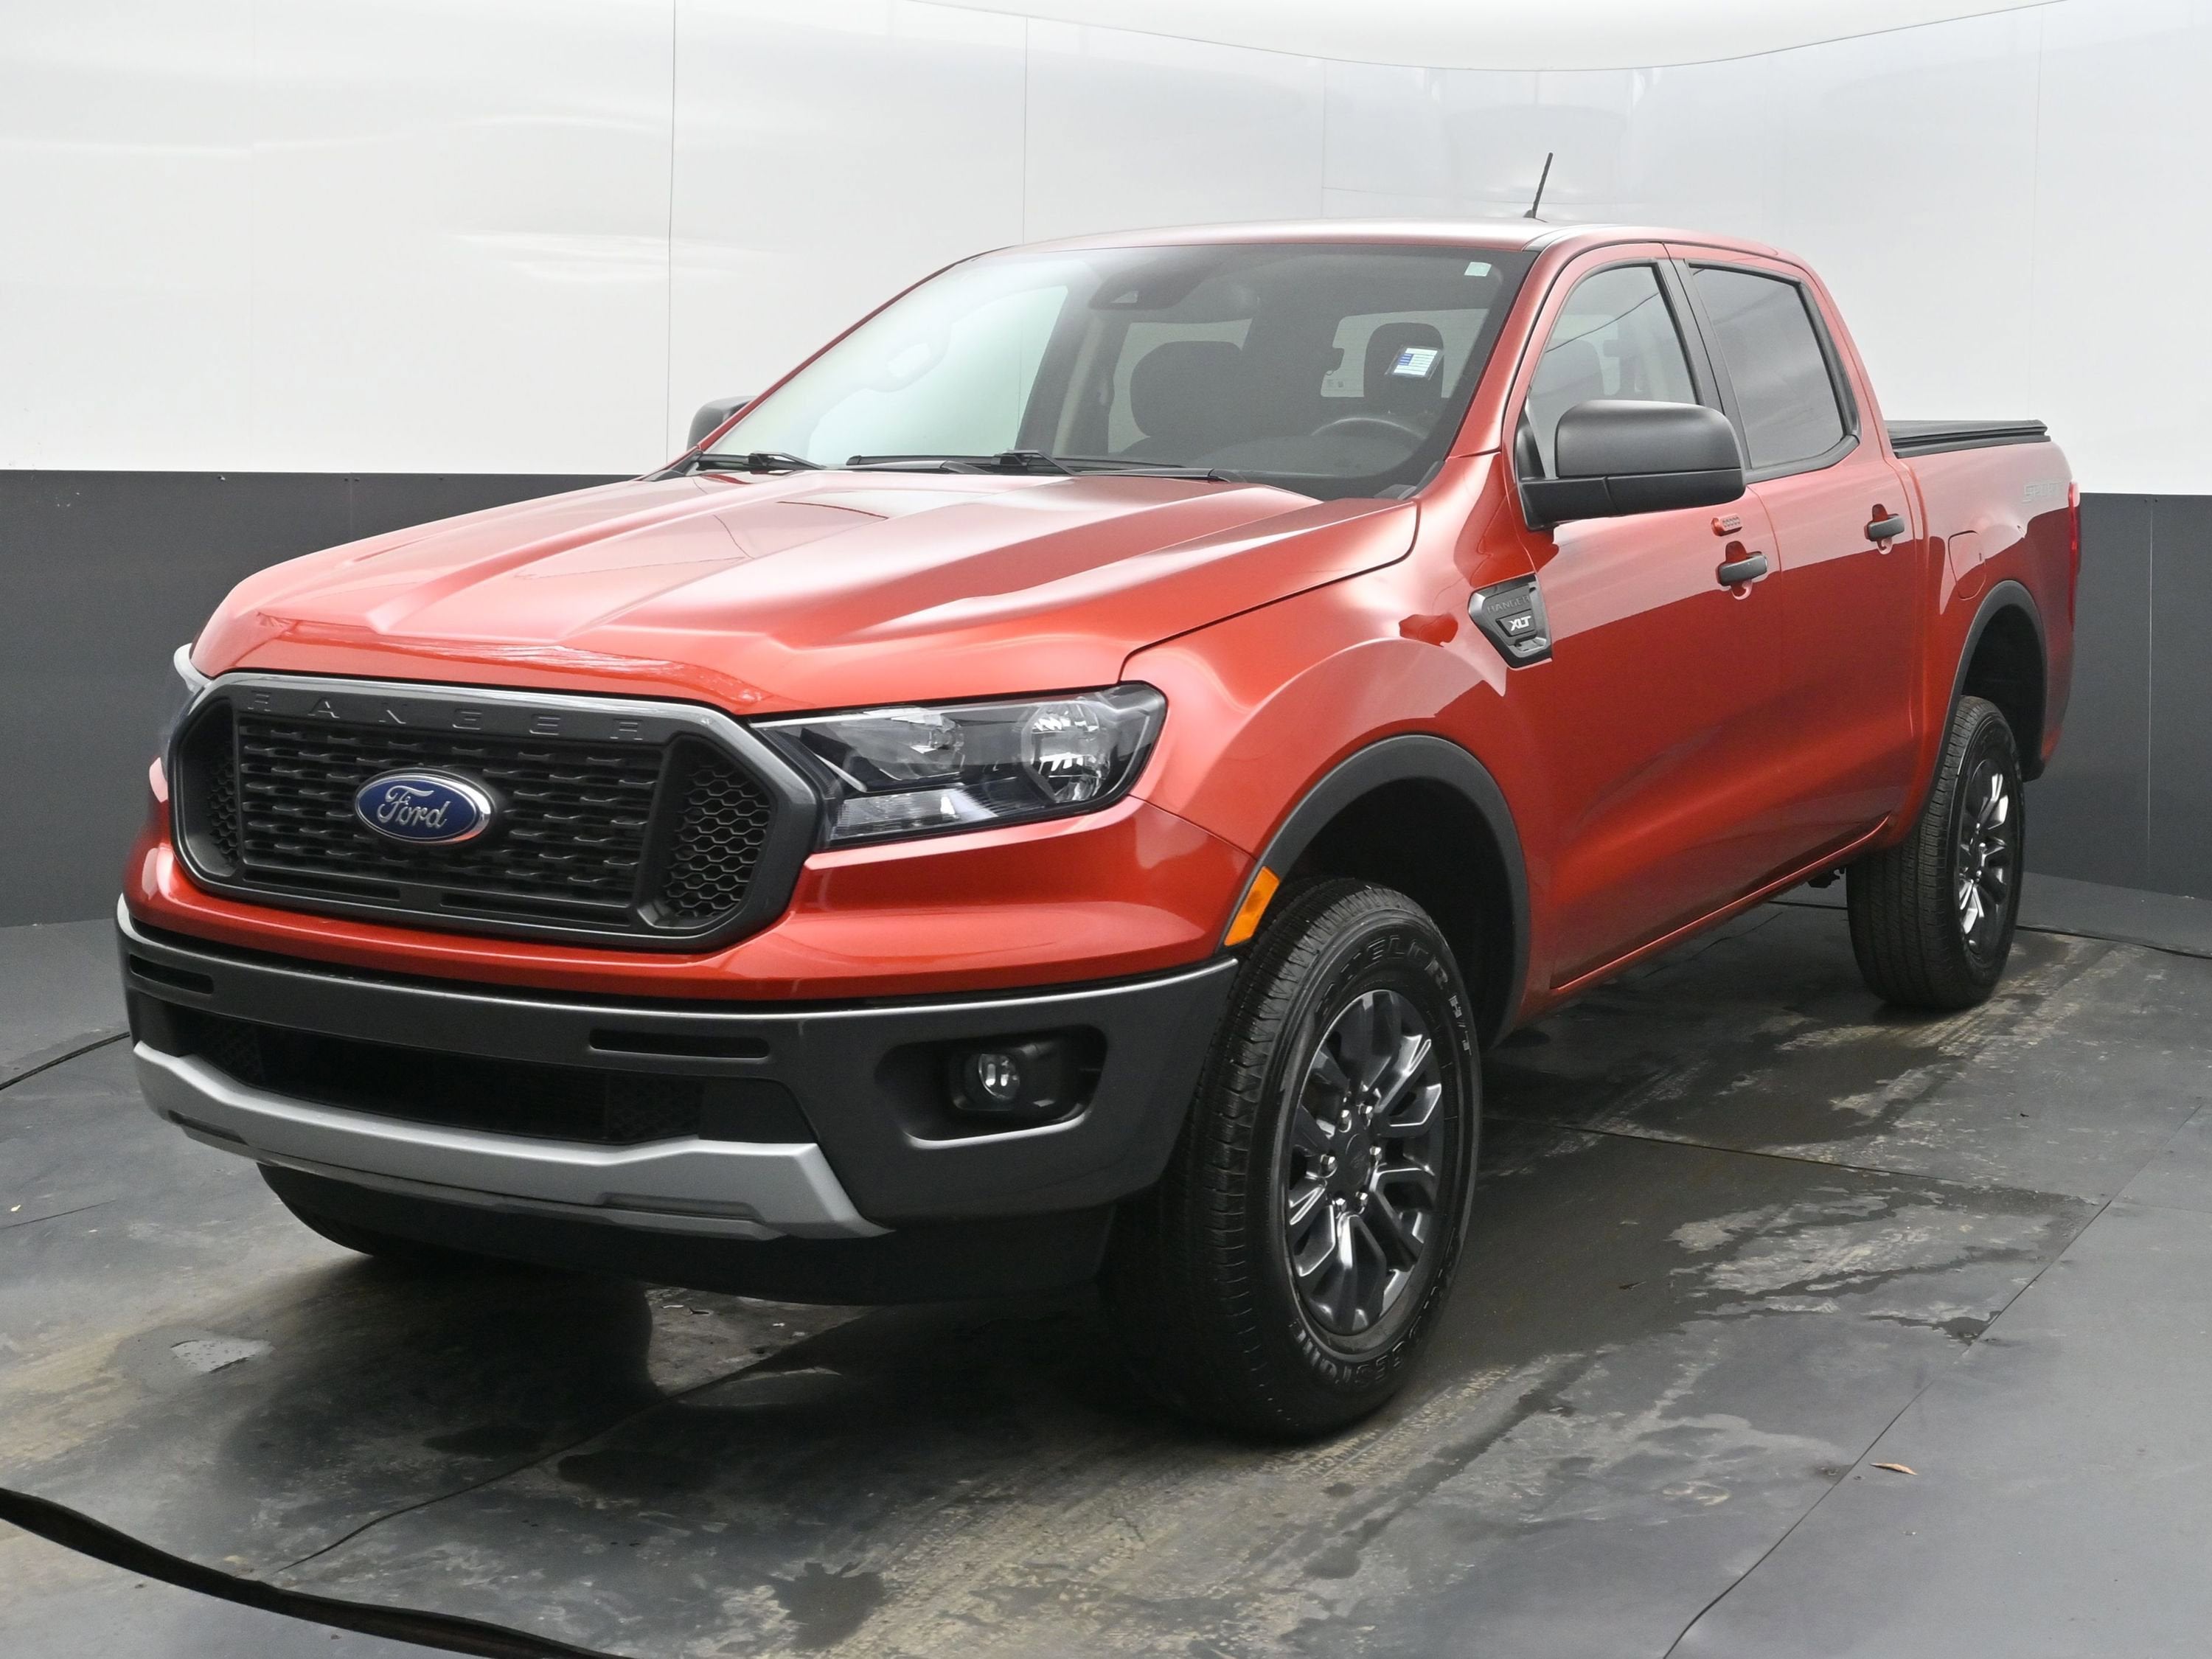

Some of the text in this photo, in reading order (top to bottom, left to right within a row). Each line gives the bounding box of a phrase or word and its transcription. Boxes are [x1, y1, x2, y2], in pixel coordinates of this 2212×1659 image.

[1486, 594, 1530, 614] RANGER
[1508, 615, 1531, 631] XLT
[248, 690, 644, 741] RANGER
[377, 785, 451, 829] Ford
